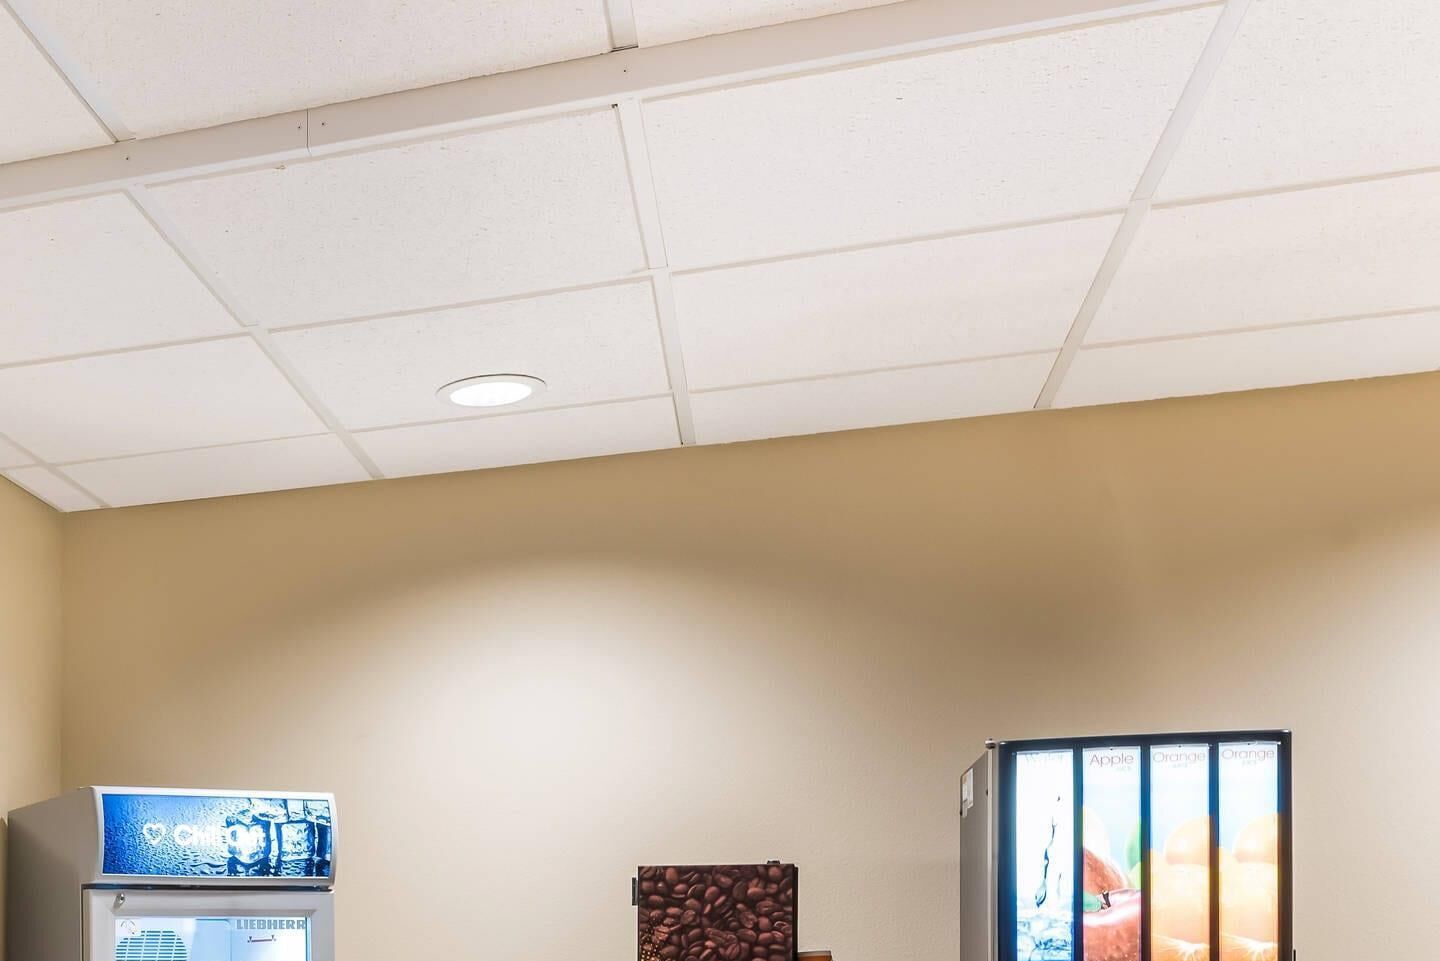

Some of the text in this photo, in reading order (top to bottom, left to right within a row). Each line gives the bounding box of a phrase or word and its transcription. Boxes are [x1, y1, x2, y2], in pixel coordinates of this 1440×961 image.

[1089, 752, 1134, 767] Apple
[1152, 751, 1206, 763] Orange
[1222, 748, 1274, 761] Orange
[236, 919, 306, 930] LIEBHERR
